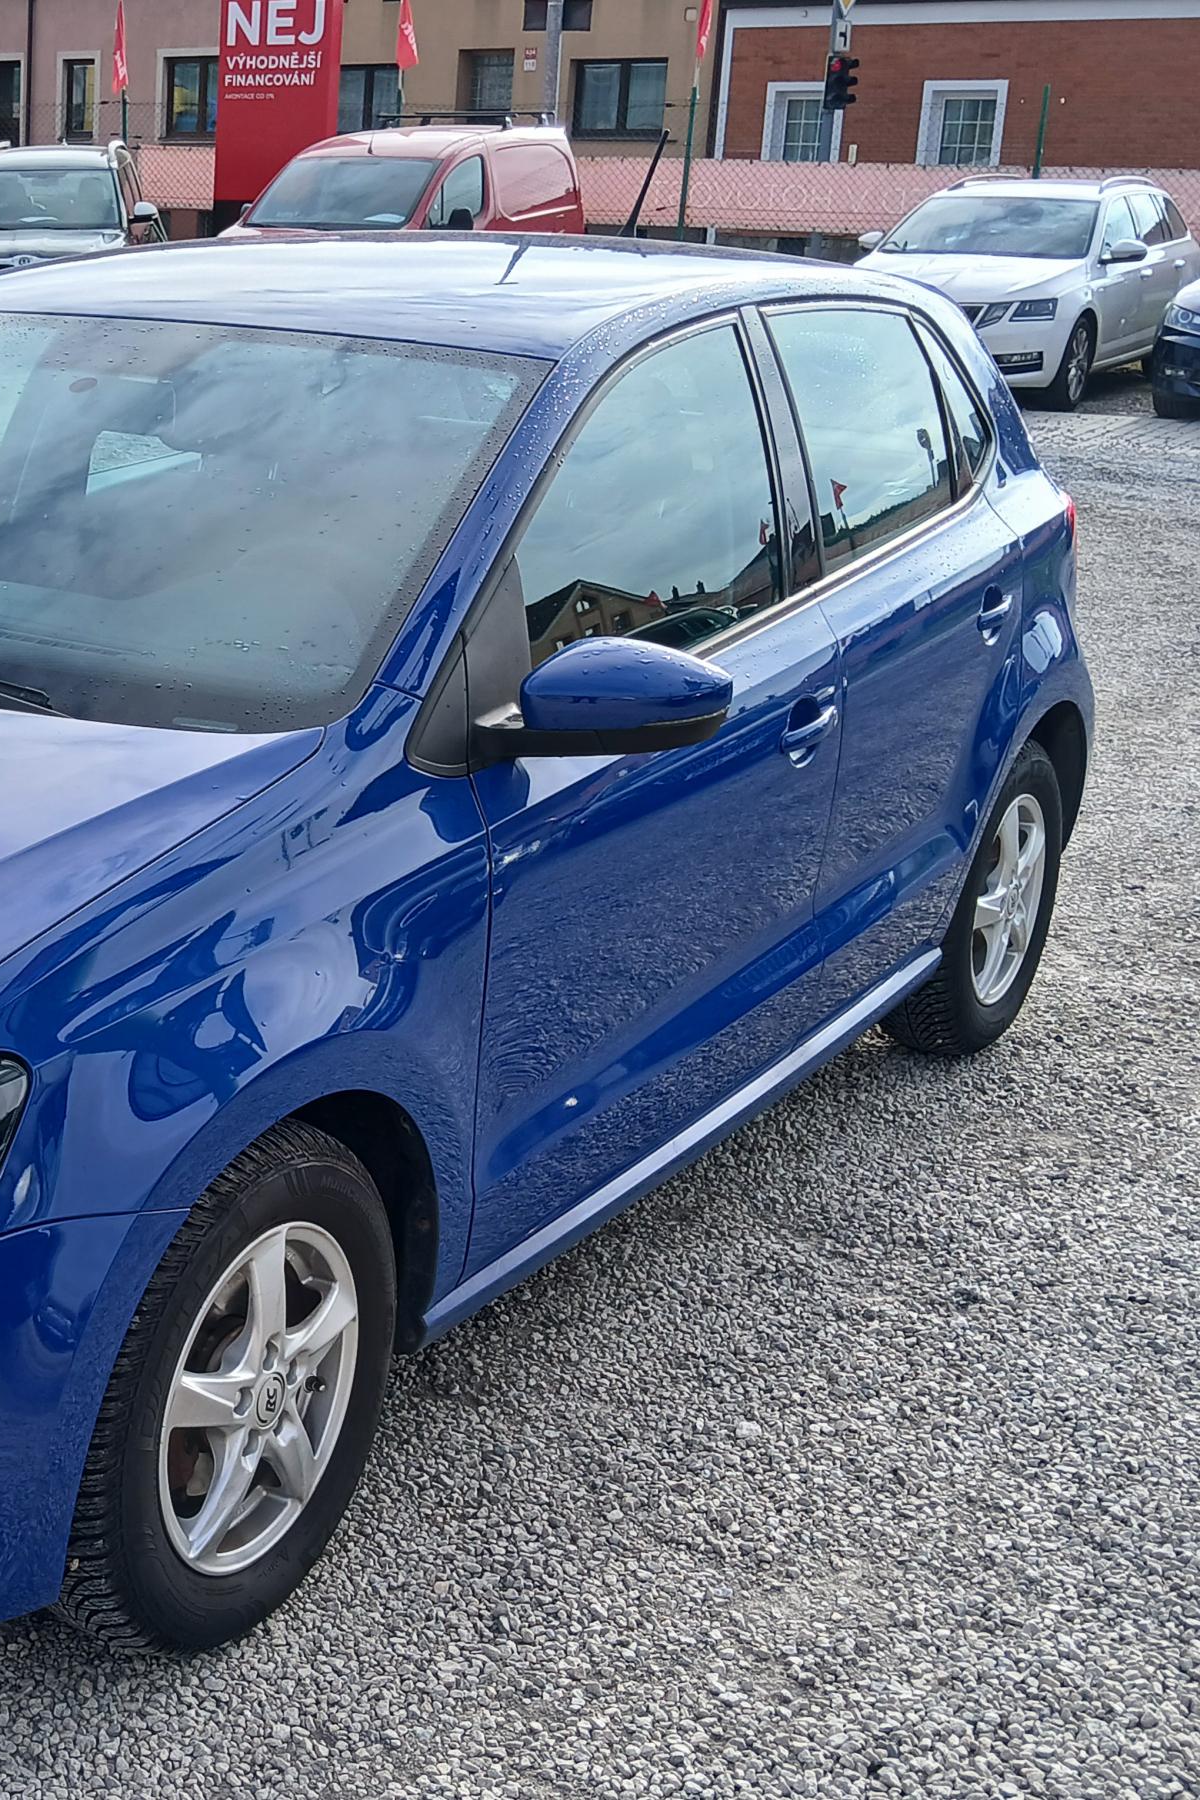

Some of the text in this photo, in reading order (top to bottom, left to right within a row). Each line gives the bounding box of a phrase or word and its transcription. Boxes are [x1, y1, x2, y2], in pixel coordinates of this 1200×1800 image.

[226, 0, 326, 46] NEJ
[226, 52, 322, 70] VÝHODNĚJŠÍ
[224, 71, 315, 86] FINANCOVÁNÍ
